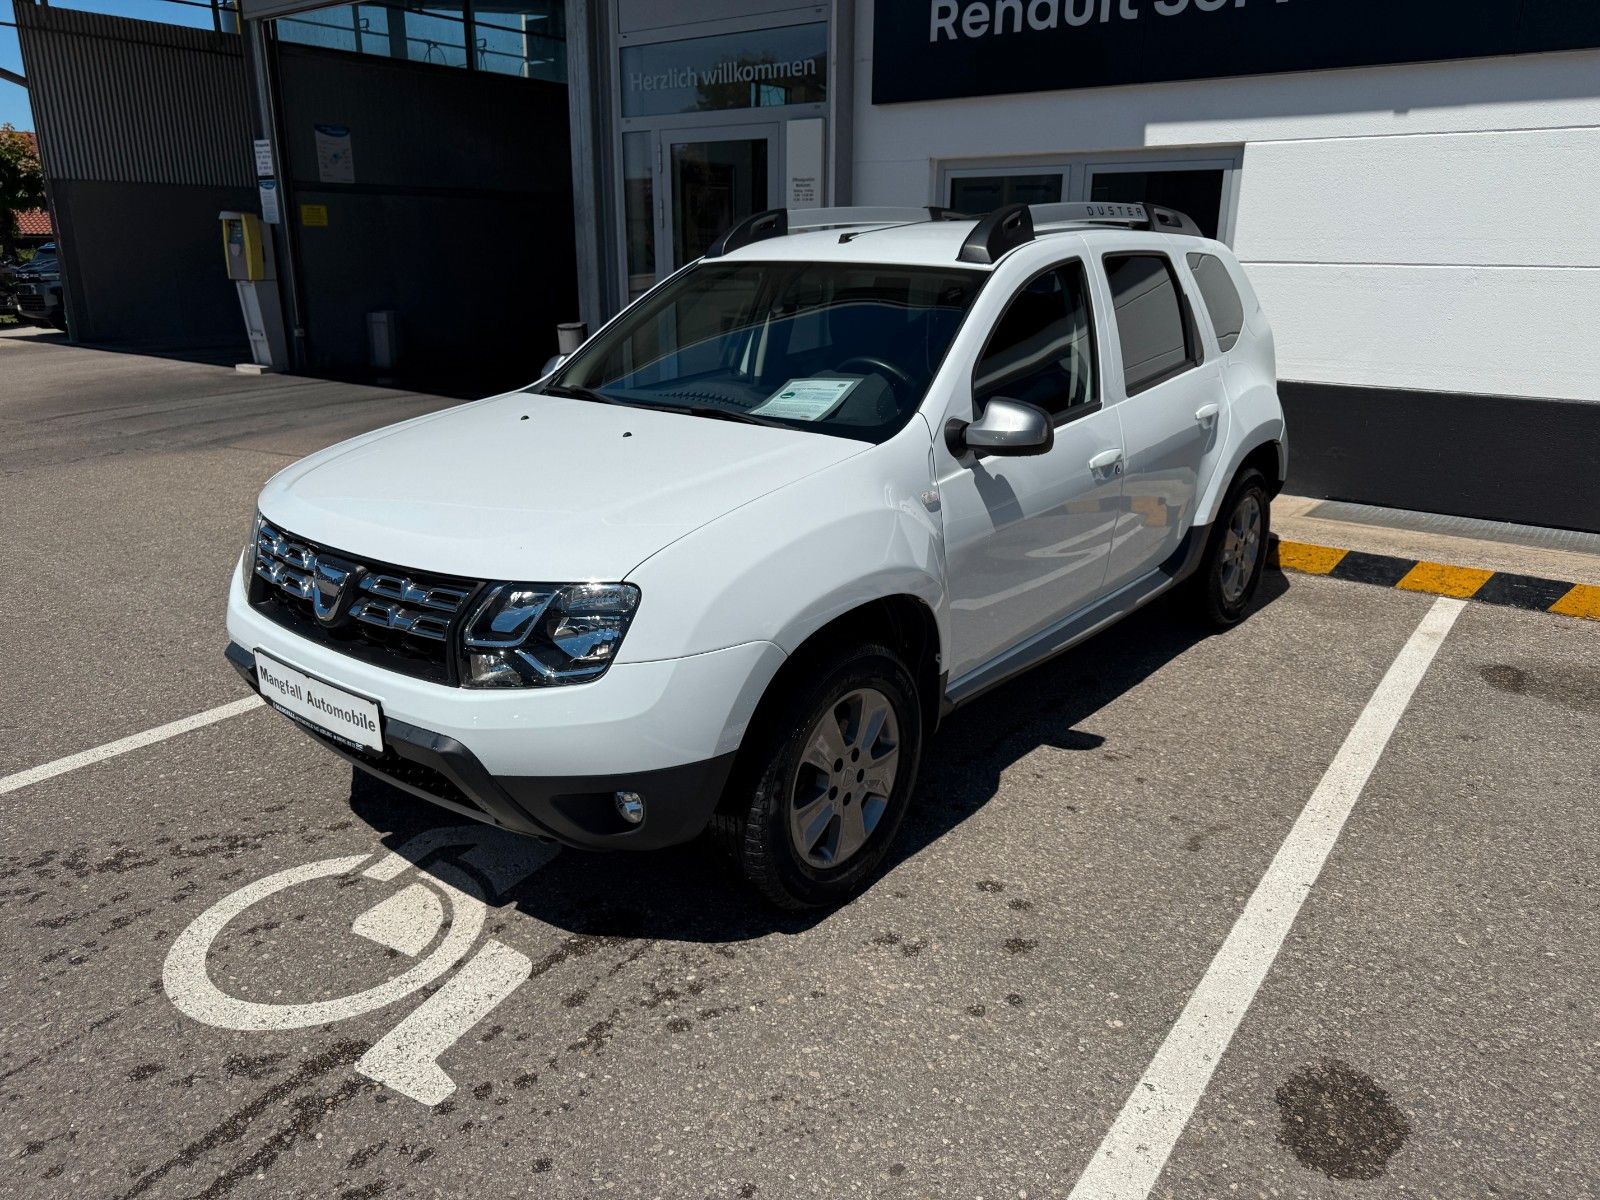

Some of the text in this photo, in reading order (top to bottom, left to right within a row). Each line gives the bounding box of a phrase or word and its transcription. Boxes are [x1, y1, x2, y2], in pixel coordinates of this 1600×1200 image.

[629, 57, 817, 92] Herzlich willkommen
[1086, 205, 1143, 217] DUSTER
[259, 665, 303, 701] Mangfall
[306, 690, 376, 733] Automobile
